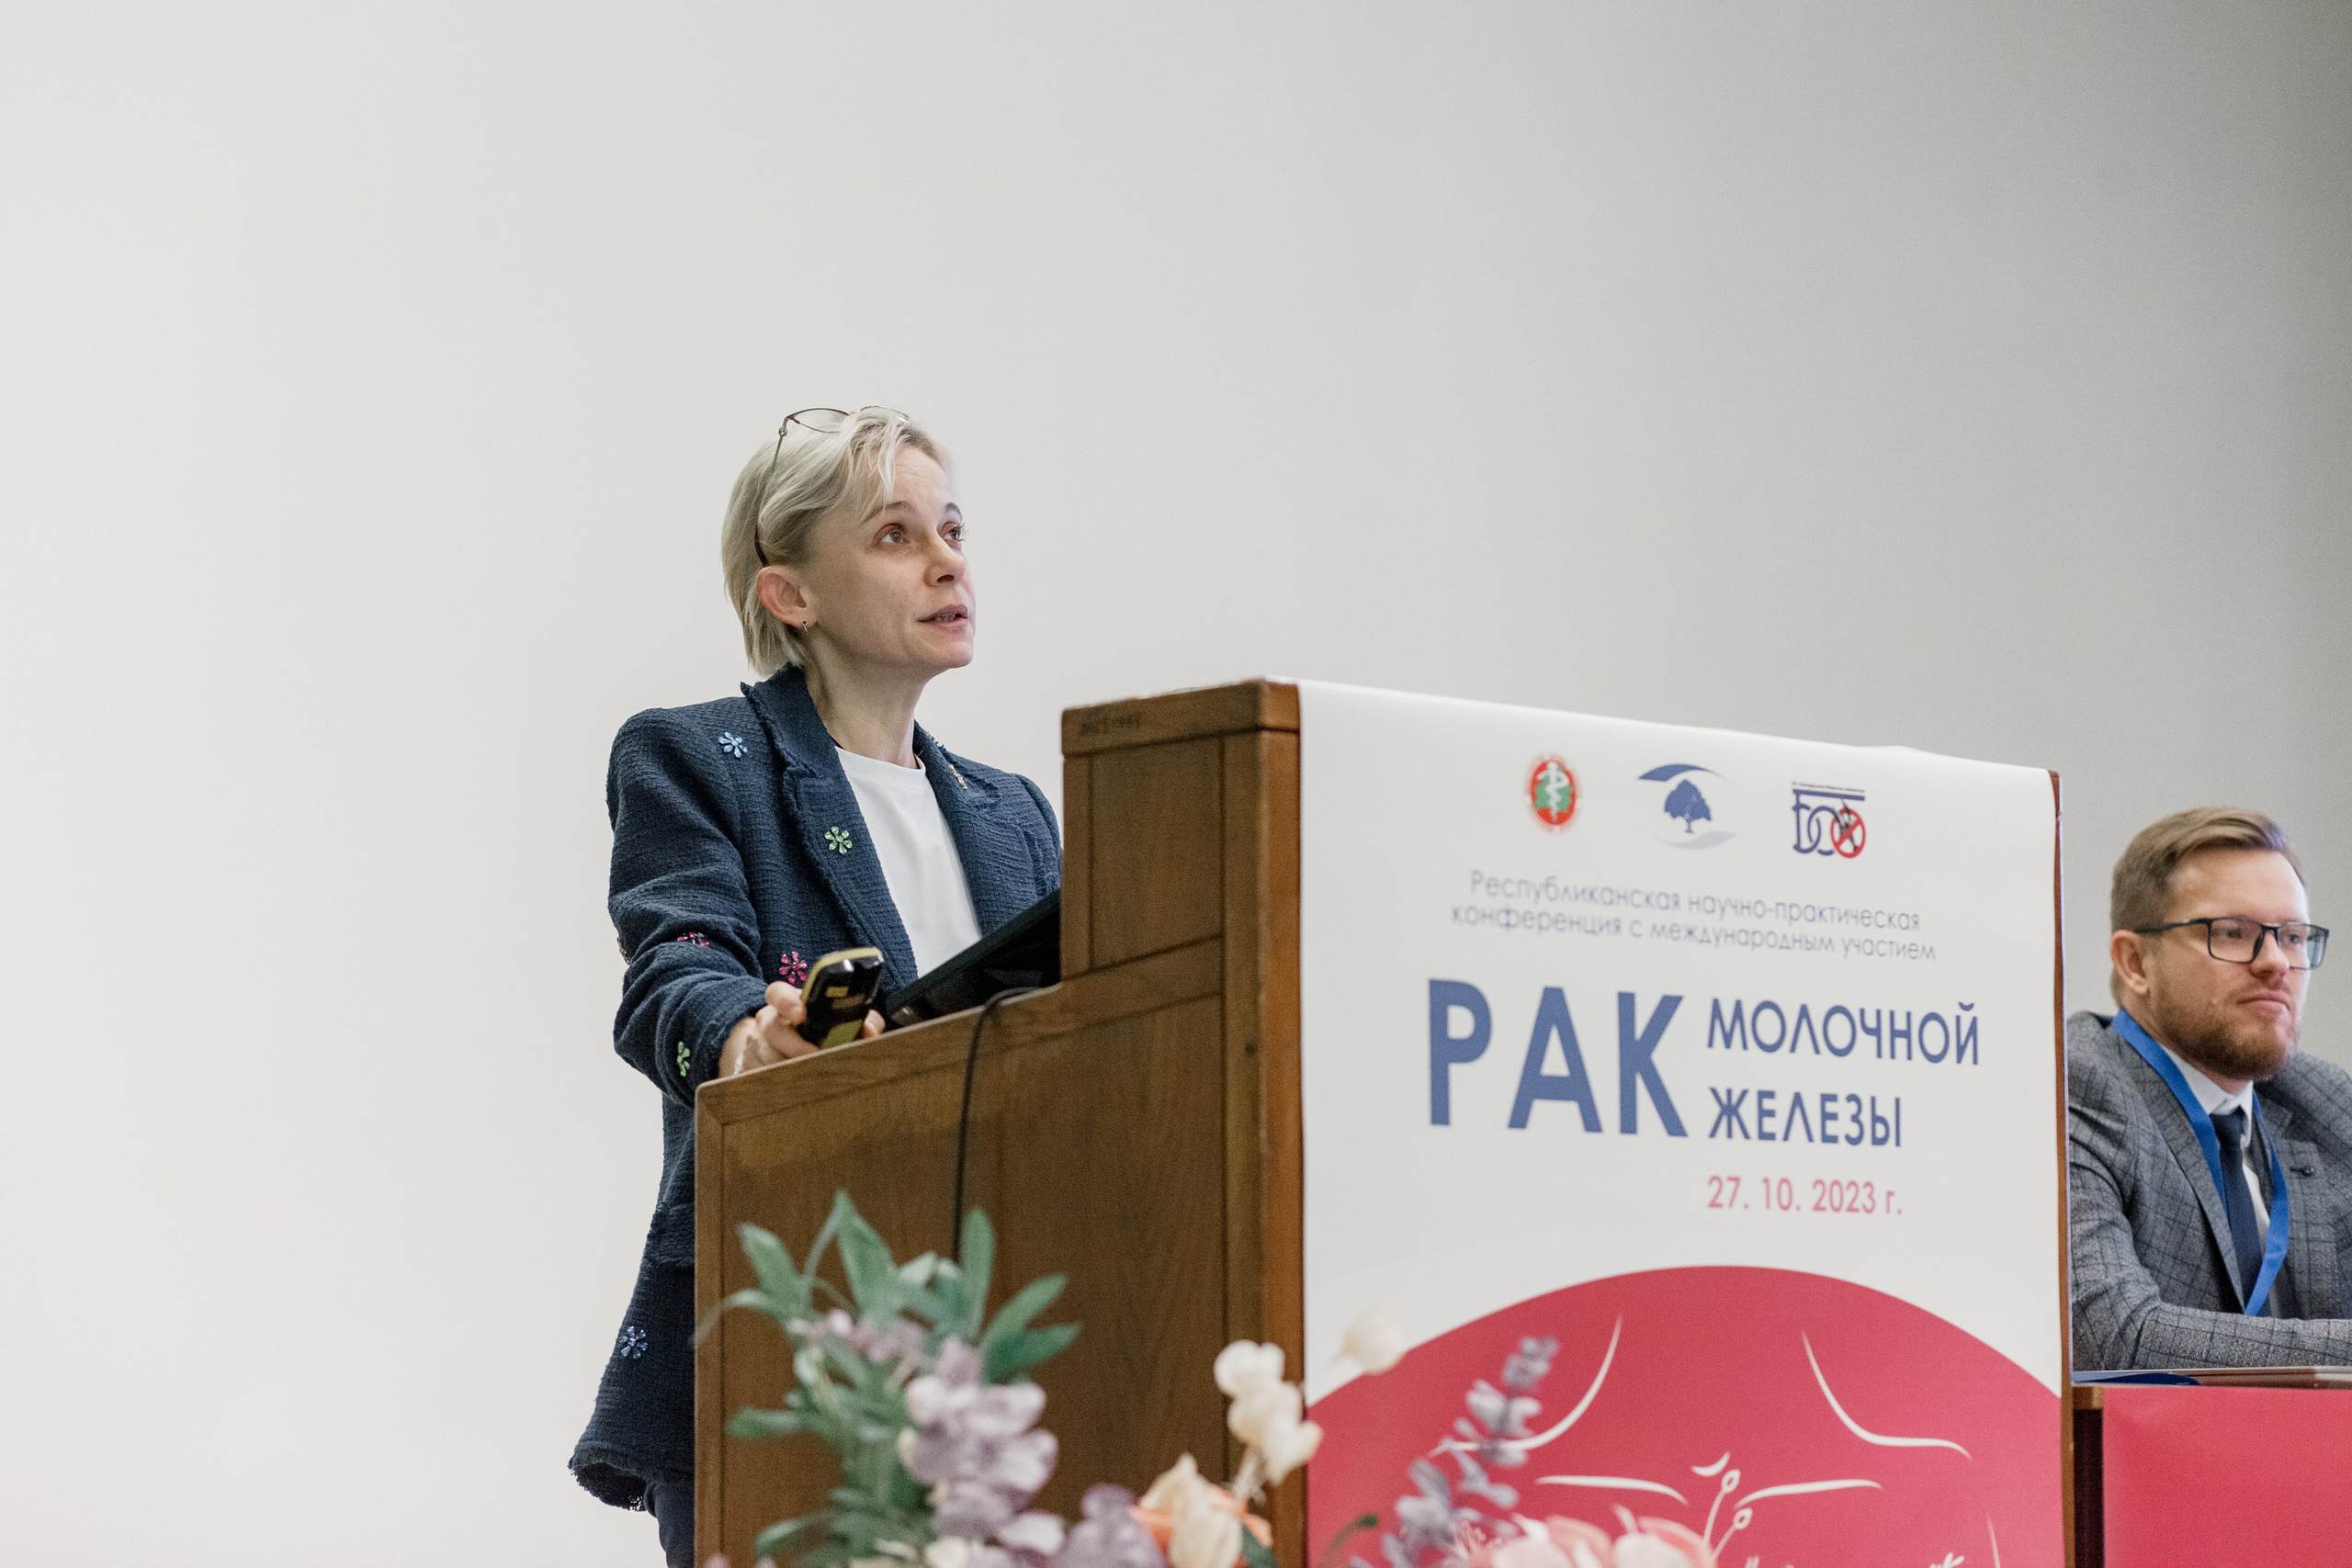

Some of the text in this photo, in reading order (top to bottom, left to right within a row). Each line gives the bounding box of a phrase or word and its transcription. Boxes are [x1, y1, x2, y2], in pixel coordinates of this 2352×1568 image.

[1468, 869, 1920, 931] Республиканская научно-практическая
[1452, 903, 1936, 961] конференция с международным участием
[1429, 978, 1689, 1138] РАК
[1707, 998, 1979, 1066] МОЛОЧНОЙ
[1708, 1087, 1902, 1147] ЖЕЛЕЗЫ
[1707, 1175, 1902, 1215] 27. 10. 2023 г.
